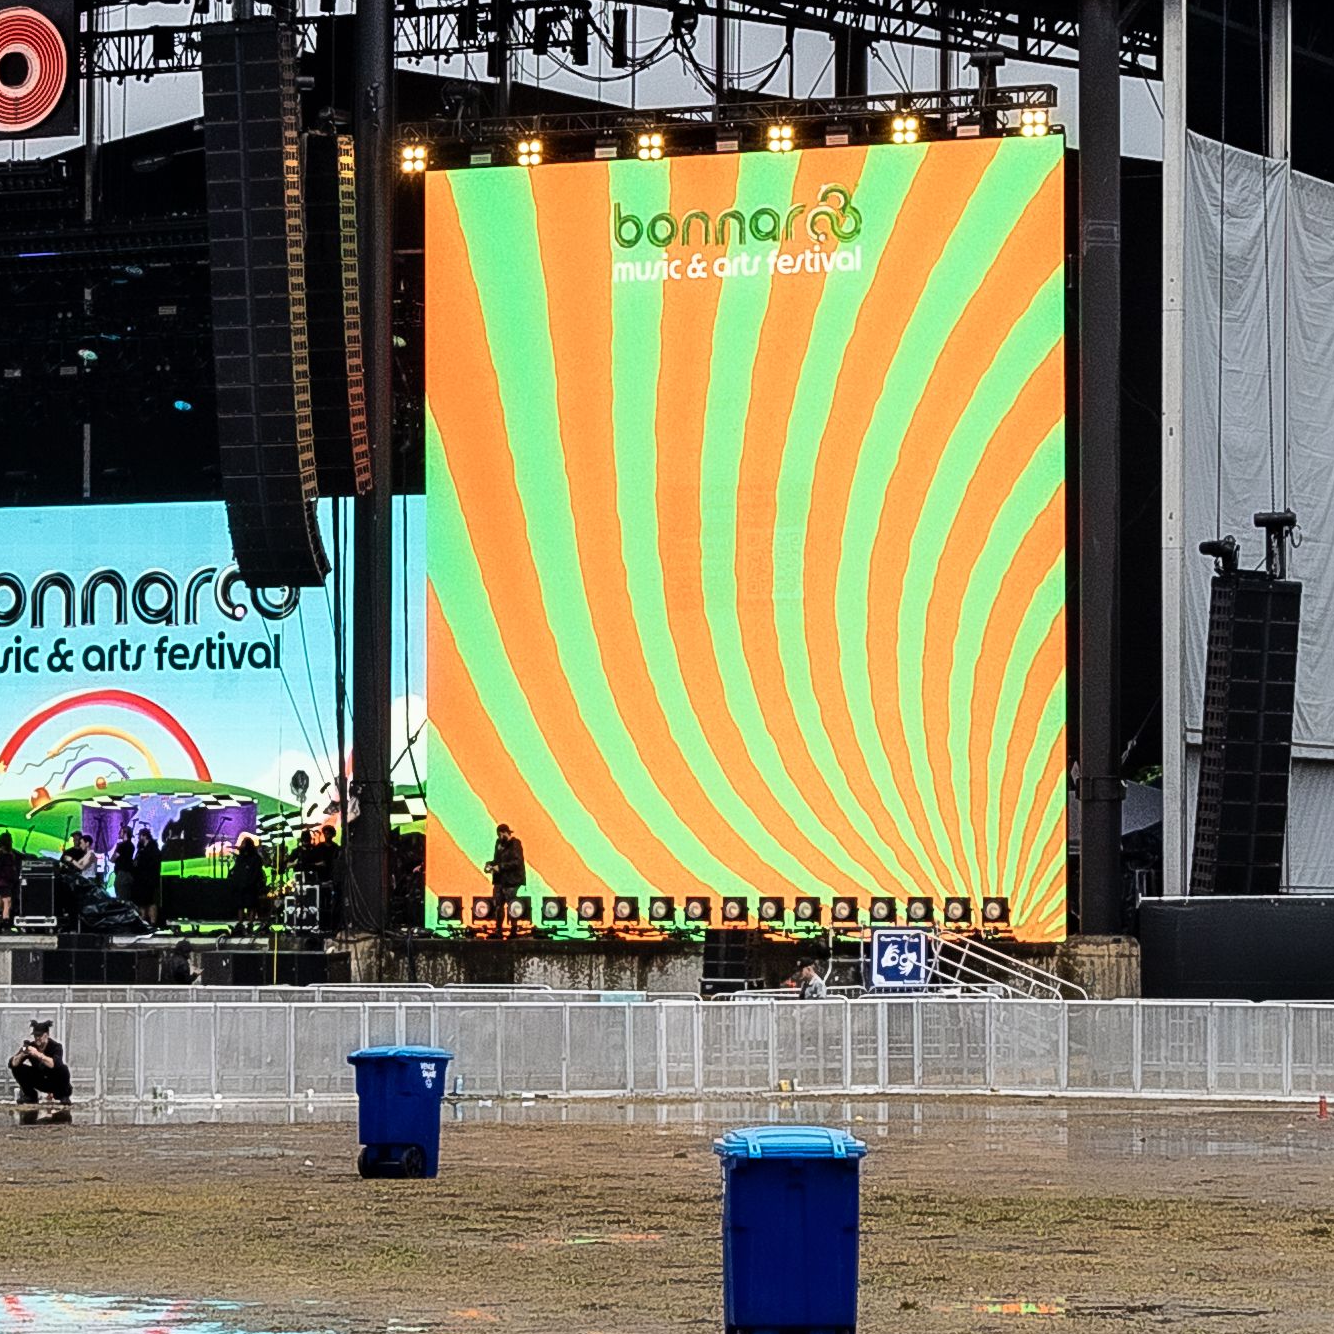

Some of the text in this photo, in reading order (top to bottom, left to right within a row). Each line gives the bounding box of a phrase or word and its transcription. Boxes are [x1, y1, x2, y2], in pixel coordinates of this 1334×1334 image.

[612, 244, 863, 283] music & arts festival
[46, 637, 74, 672] &
[82, 637, 147, 672] arts
[153, 630, 281, 671] festival
